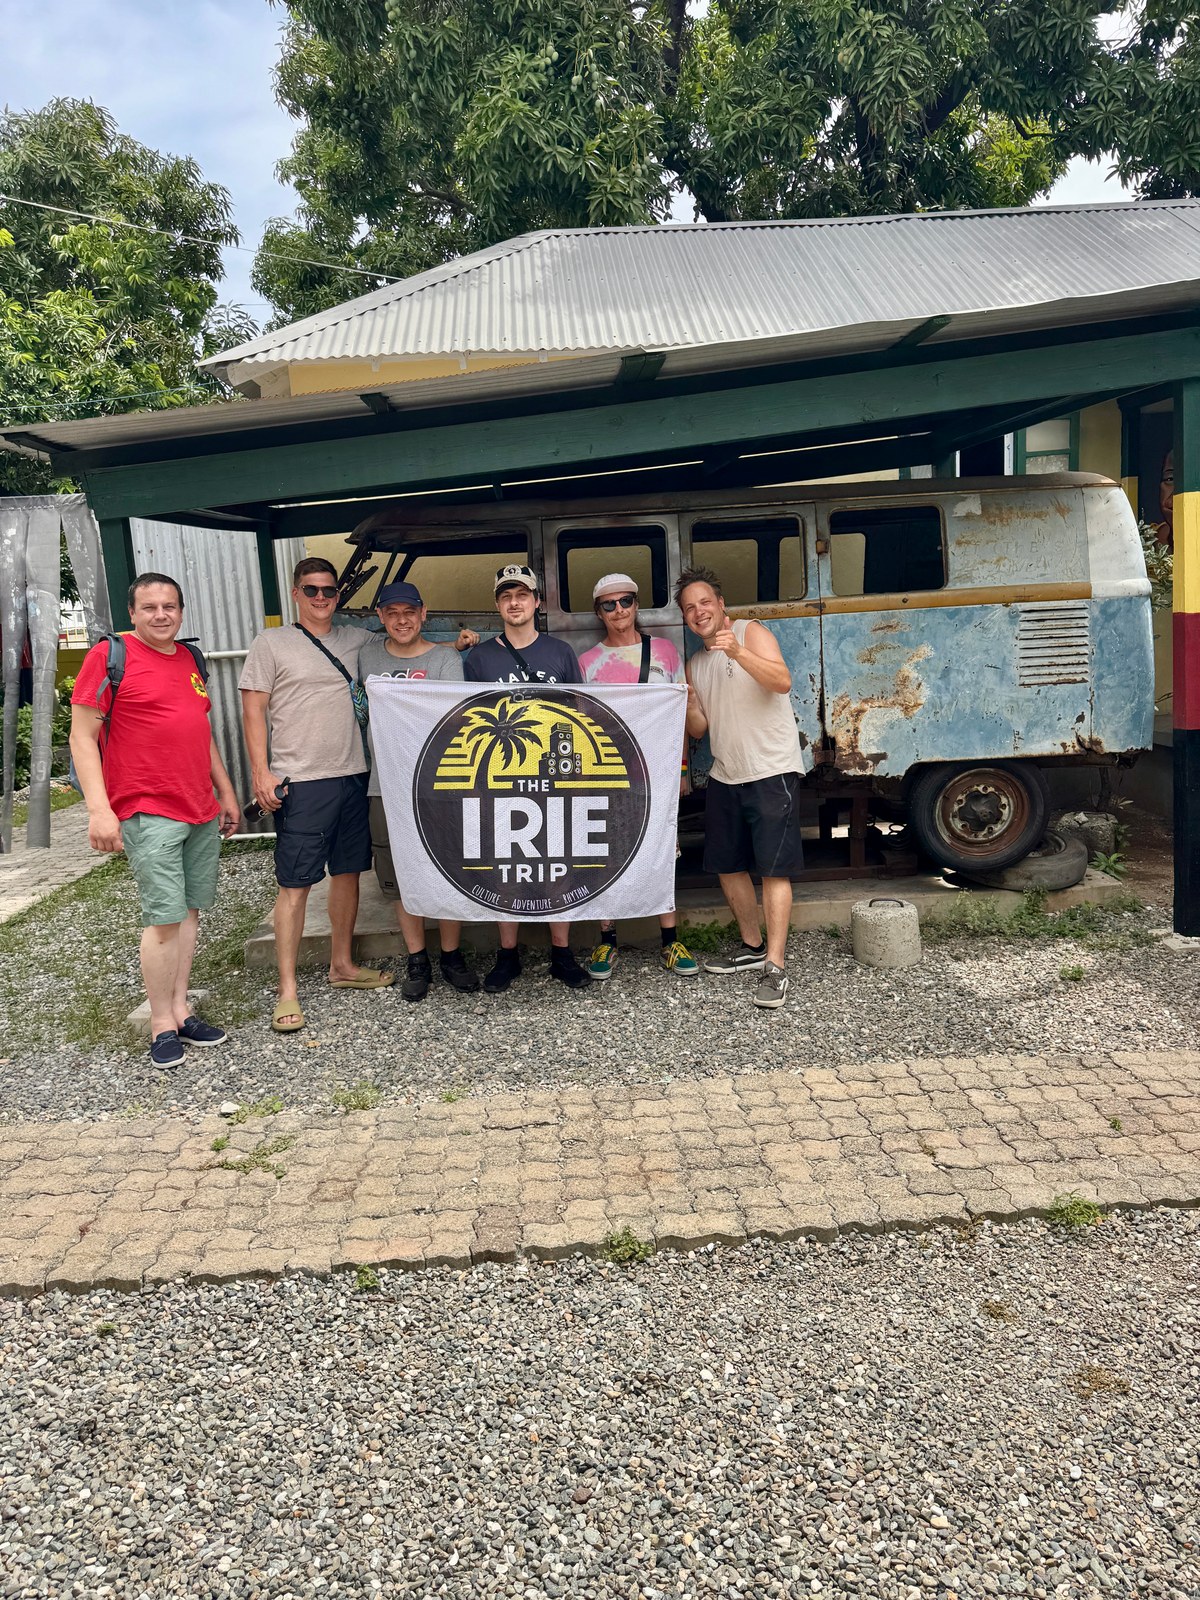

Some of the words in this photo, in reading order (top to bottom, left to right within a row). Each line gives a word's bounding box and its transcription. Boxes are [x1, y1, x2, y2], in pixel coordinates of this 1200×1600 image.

[517, 779, 550, 792] THE
[462, 796, 609, 859] IRIE
[498, 863, 568, 883] TRIP
[471, 884, 501, 905] CULTURE
[512, 898, 553, 911] ADVENTURE
[562, 884, 590, 905] RHYTHM
